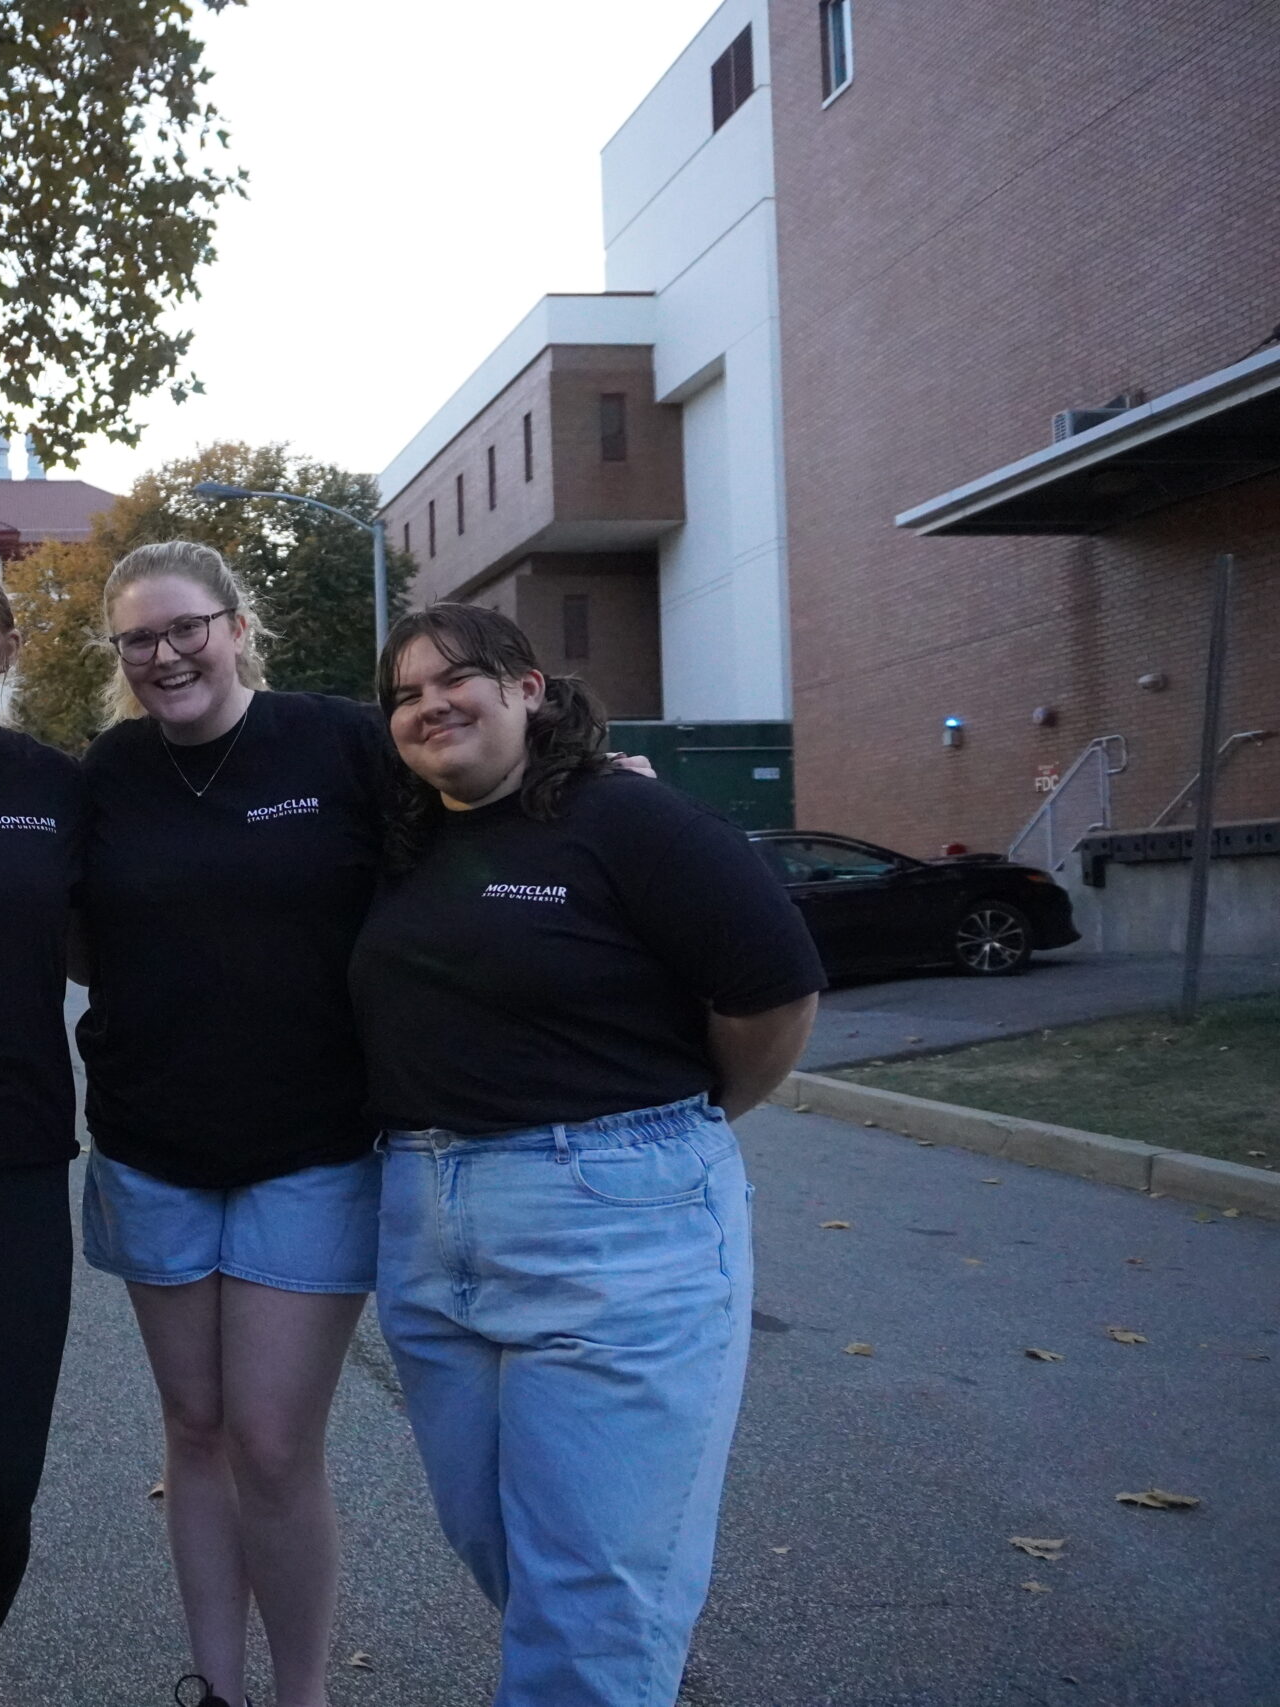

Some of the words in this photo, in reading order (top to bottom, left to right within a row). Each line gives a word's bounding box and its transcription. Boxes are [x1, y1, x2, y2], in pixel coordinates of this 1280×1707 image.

[1035, 774, 1059, 792] FDC
[246, 797, 320, 817] MONTCLAIR
[247, 815, 269, 823] STATE
[273, 807, 320, 818] UNIVERSITY
[17, 824, 58, 834] UNIVERSITY
[485, 883, 568, 898] MONTCLAIR
[509, 893, 567, 905] UNIVERSITY
